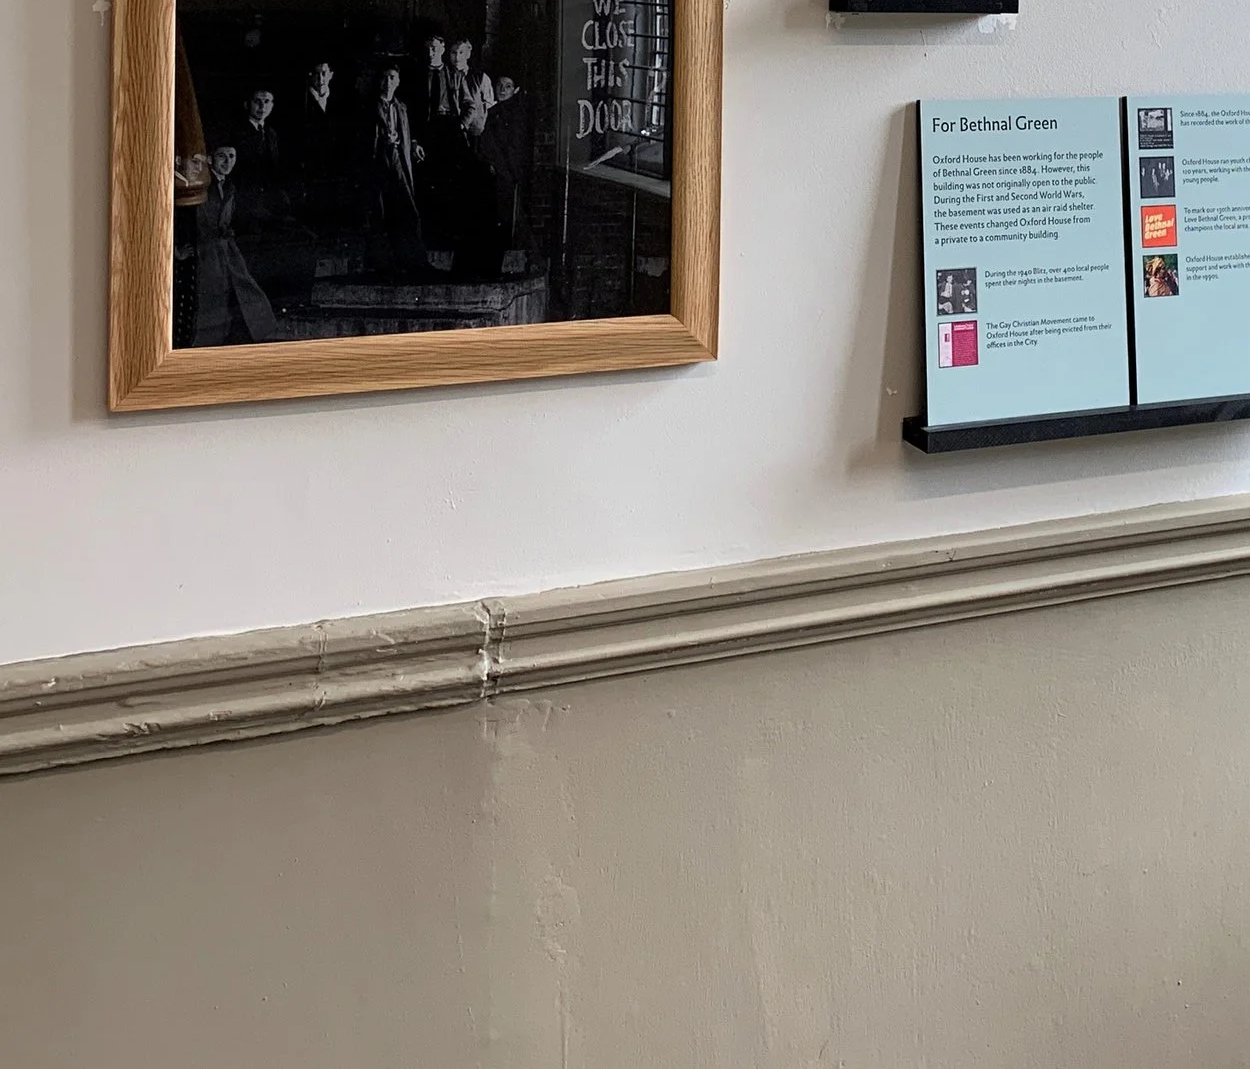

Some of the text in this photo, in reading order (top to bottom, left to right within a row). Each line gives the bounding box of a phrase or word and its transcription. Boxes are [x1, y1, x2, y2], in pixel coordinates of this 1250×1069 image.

[581, 20, 635, 50] CLOSE
[582, 57, 630, 90] THIS
[576, 99, 634, 139] DOOR
[932, 116, 1058, 132] For Bethnal Green
[932, 155, 961, 164] Oxford
[962, 155, 988, 163] House
[988, 154, 1002, 162] has
[1003, 154, 1022, 162] been
[1022, 153, 1053, 162] working
[1053, 152, 1065, 160] for
[1079, 150, 1104, 161] people
[933, 169, 941, 178] of
[942, 168, 972, 177] Bethnal
[973, 167, 997, 176] Green
[1041, 165, 1076, 173] However,
[1077, 164, 1091, 172] this
[933, 182, 965, 192] building
[996, 179, 1031, 190] originally
[1032, 180, 1051, 189] open
[1061, 177, 1073, 185] the
[934, 190, 1085, 205] During the First and Second World Wars,
[934, 209, 947, 218] the
[948, 209, 986, 217] basement
[1003, 206, 1021, 214] used
[1053, 203, 1068, 212] raid
[934, 215, 1091, 231] These events changed Oxford House from
[941, 237, 969, 246] private
[985, 233, 1028, 242] community
